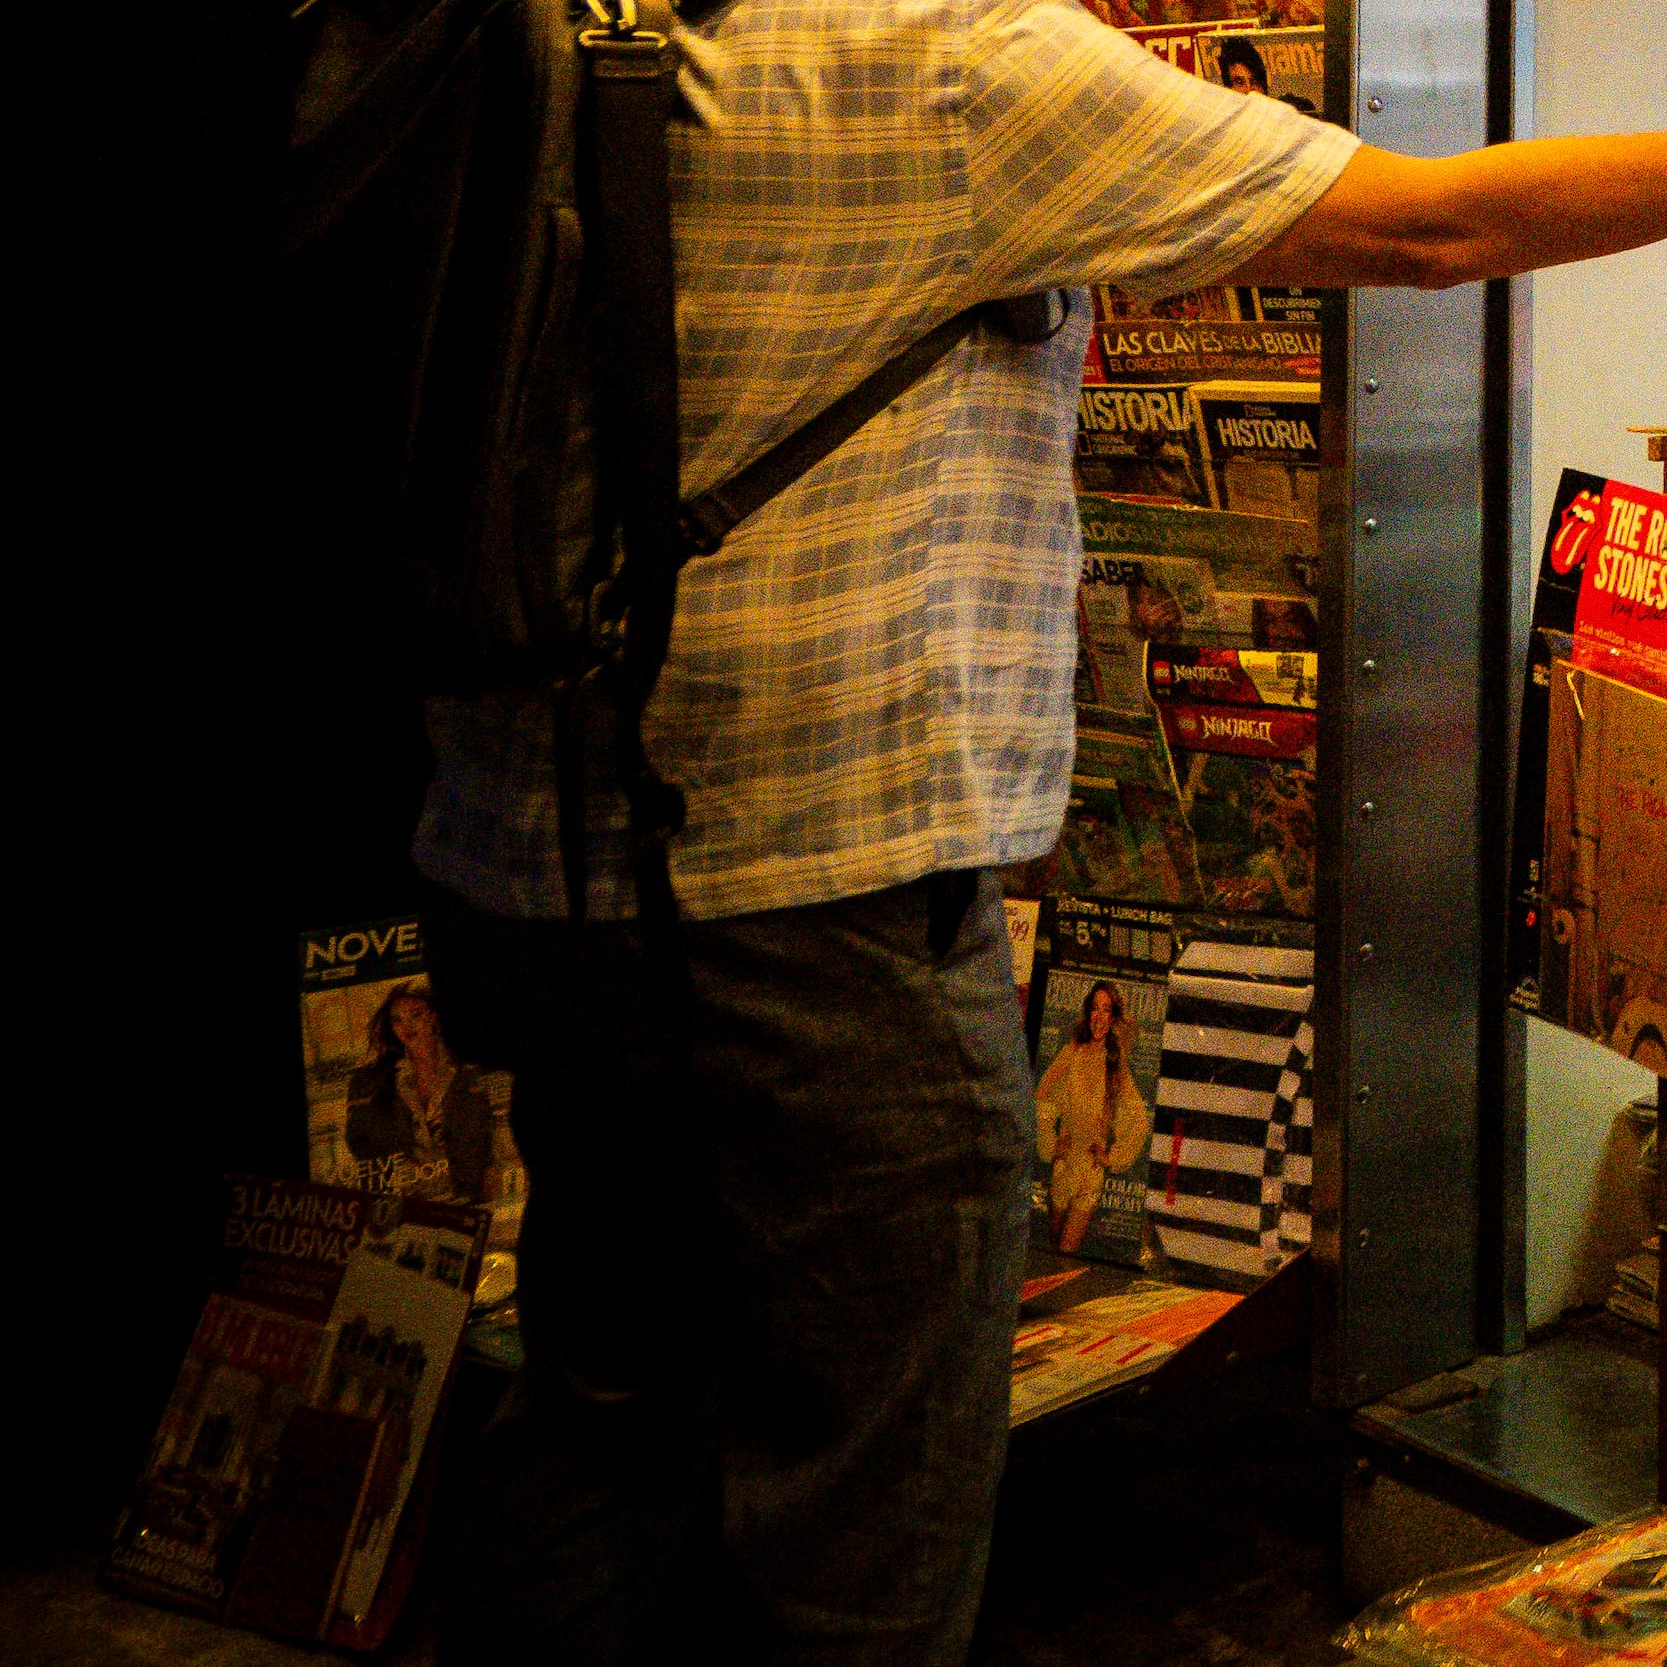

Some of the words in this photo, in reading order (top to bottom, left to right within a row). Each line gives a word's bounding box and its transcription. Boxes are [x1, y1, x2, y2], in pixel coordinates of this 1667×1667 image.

[1103, 332, 1145, 356] LAS
[1146, 330, 1225, 356] CLAVES
[1216, 417, 1318, 451] HISTORIA
[1605, 496, 1645, 550] THE
[1200, 715, 1276, 747] NINJAGO
